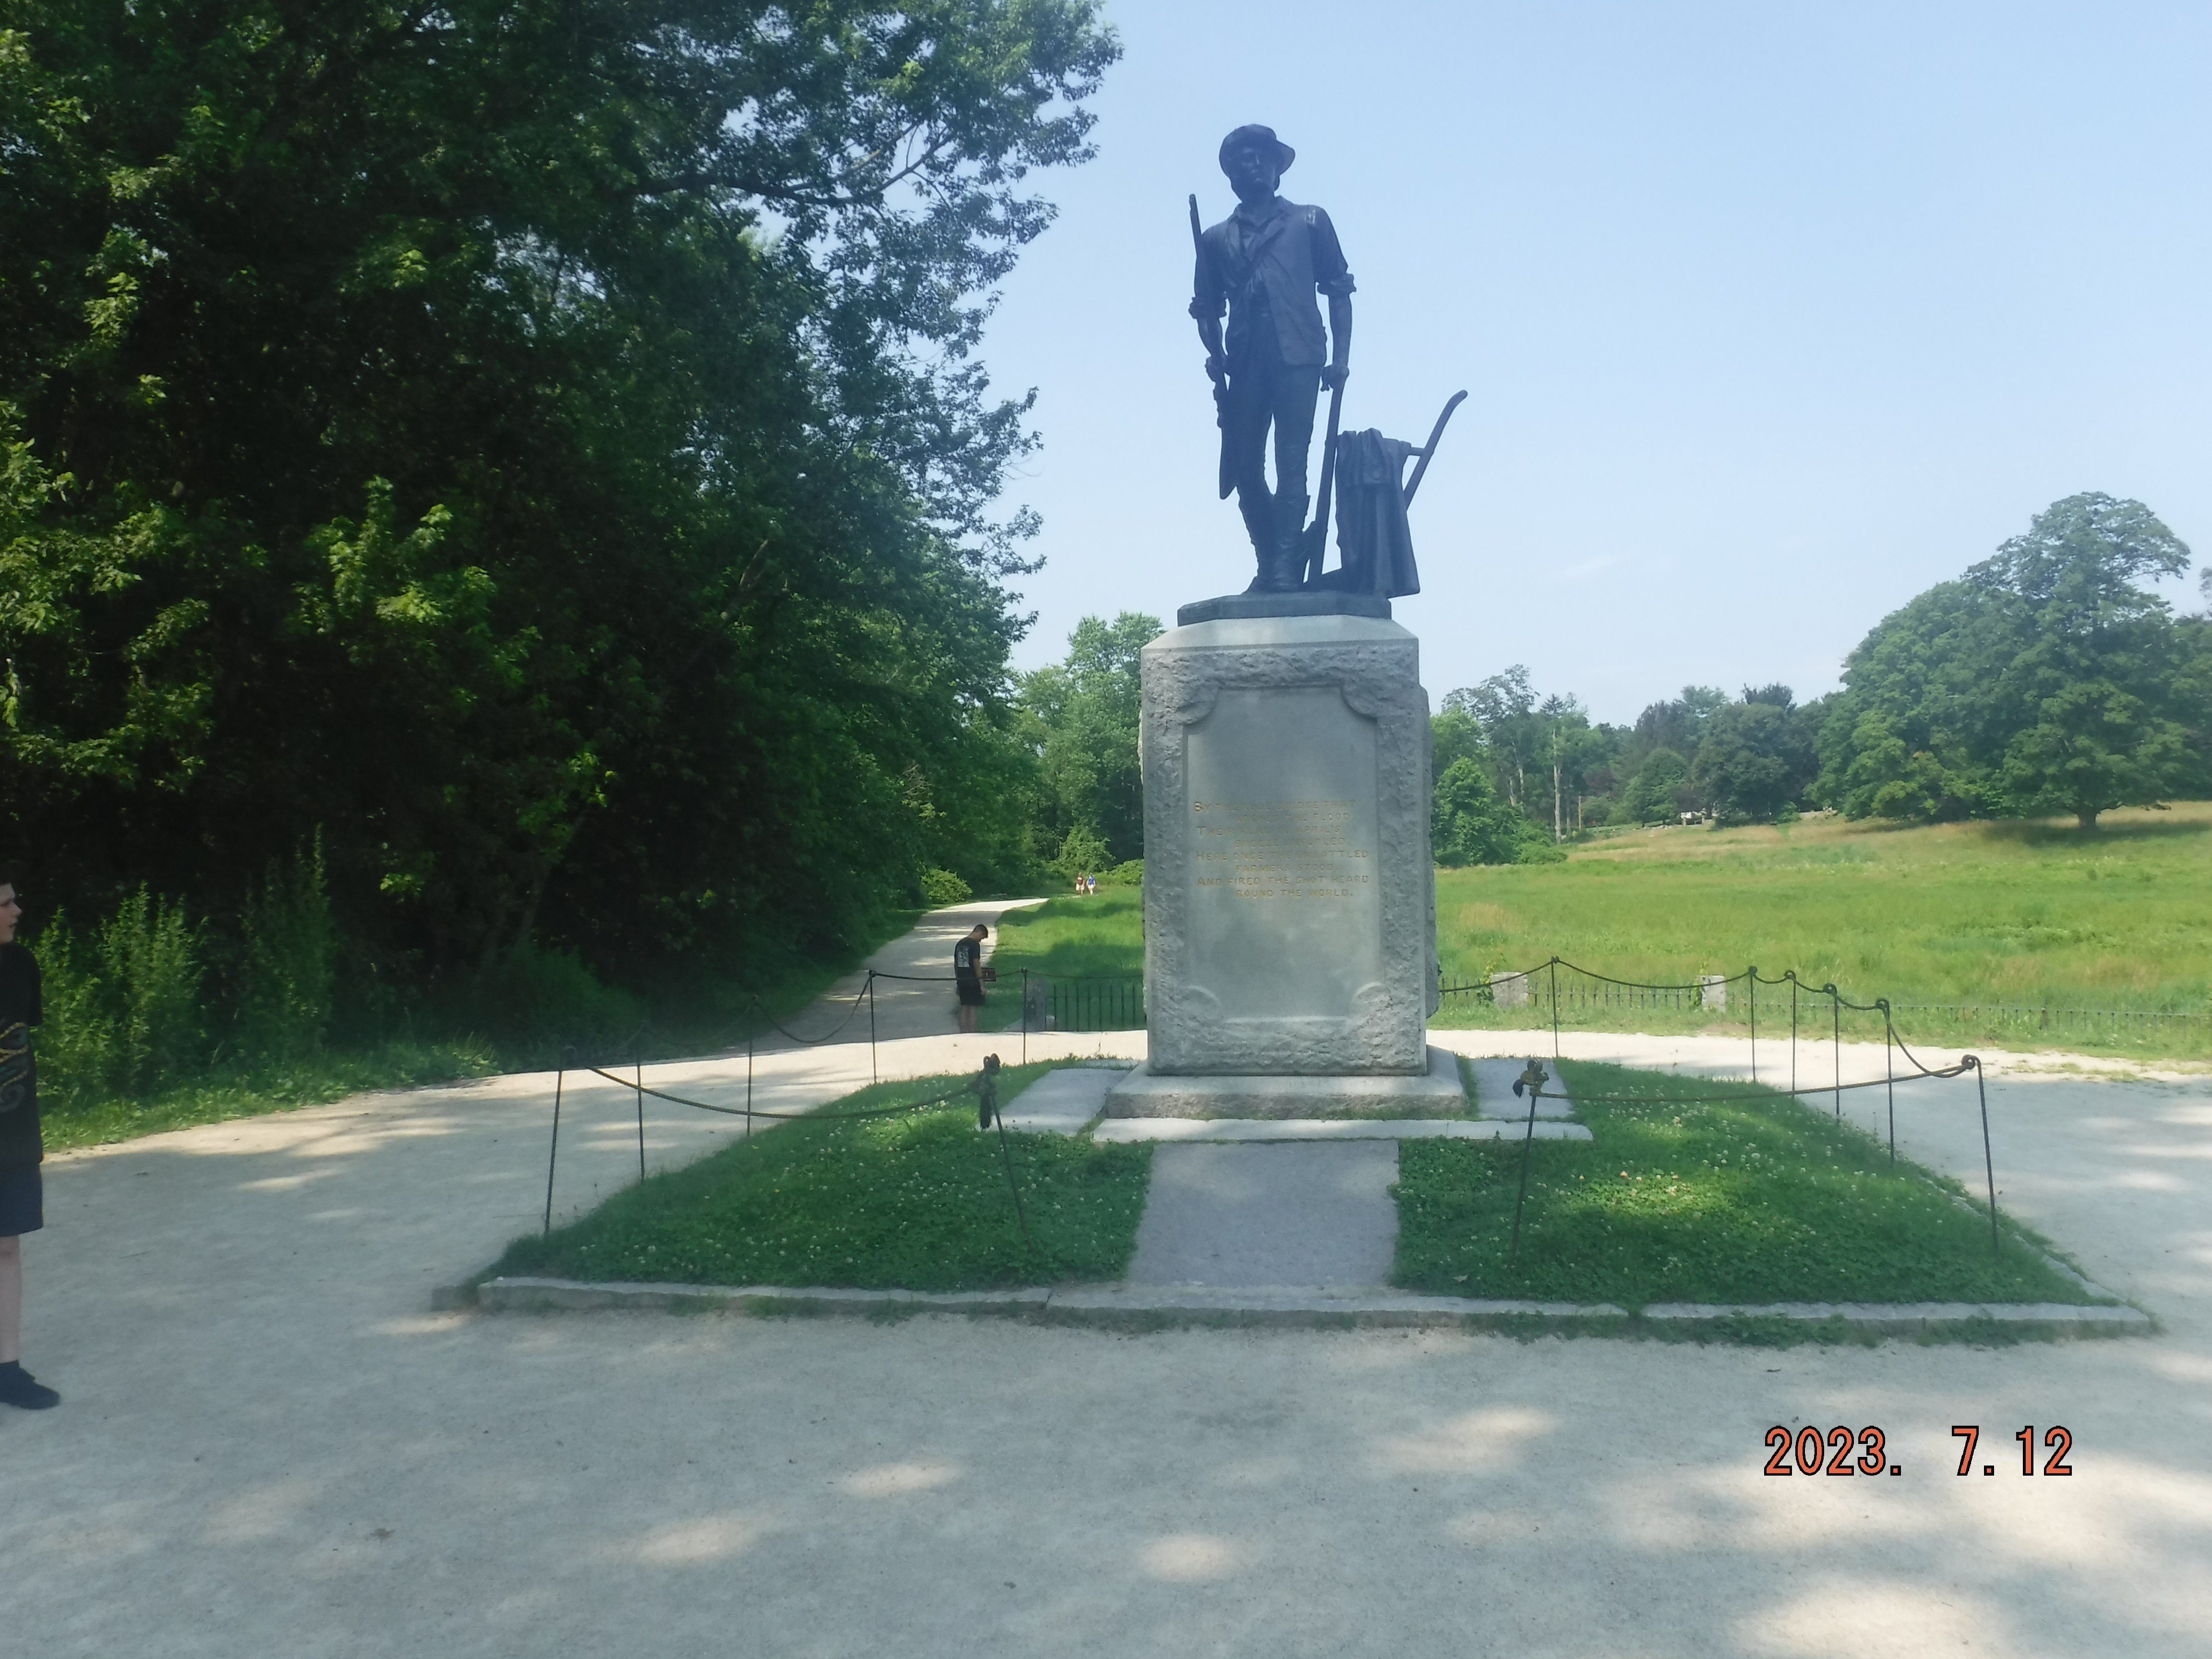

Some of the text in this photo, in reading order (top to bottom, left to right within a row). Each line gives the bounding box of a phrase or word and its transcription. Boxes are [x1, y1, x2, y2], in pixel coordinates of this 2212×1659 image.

[1196, 826, 1235, 836] THEIR
[1196, 850, 1368, 861] HERE ONCE THE EMBATTLED
[1236, 864, 1290, 872] FARMERS
[1197, 875, 1368, 887] AND FIRED THE SHOT HEARD
[1237, 888, 1353, 898] ROUND THE WORLD.
